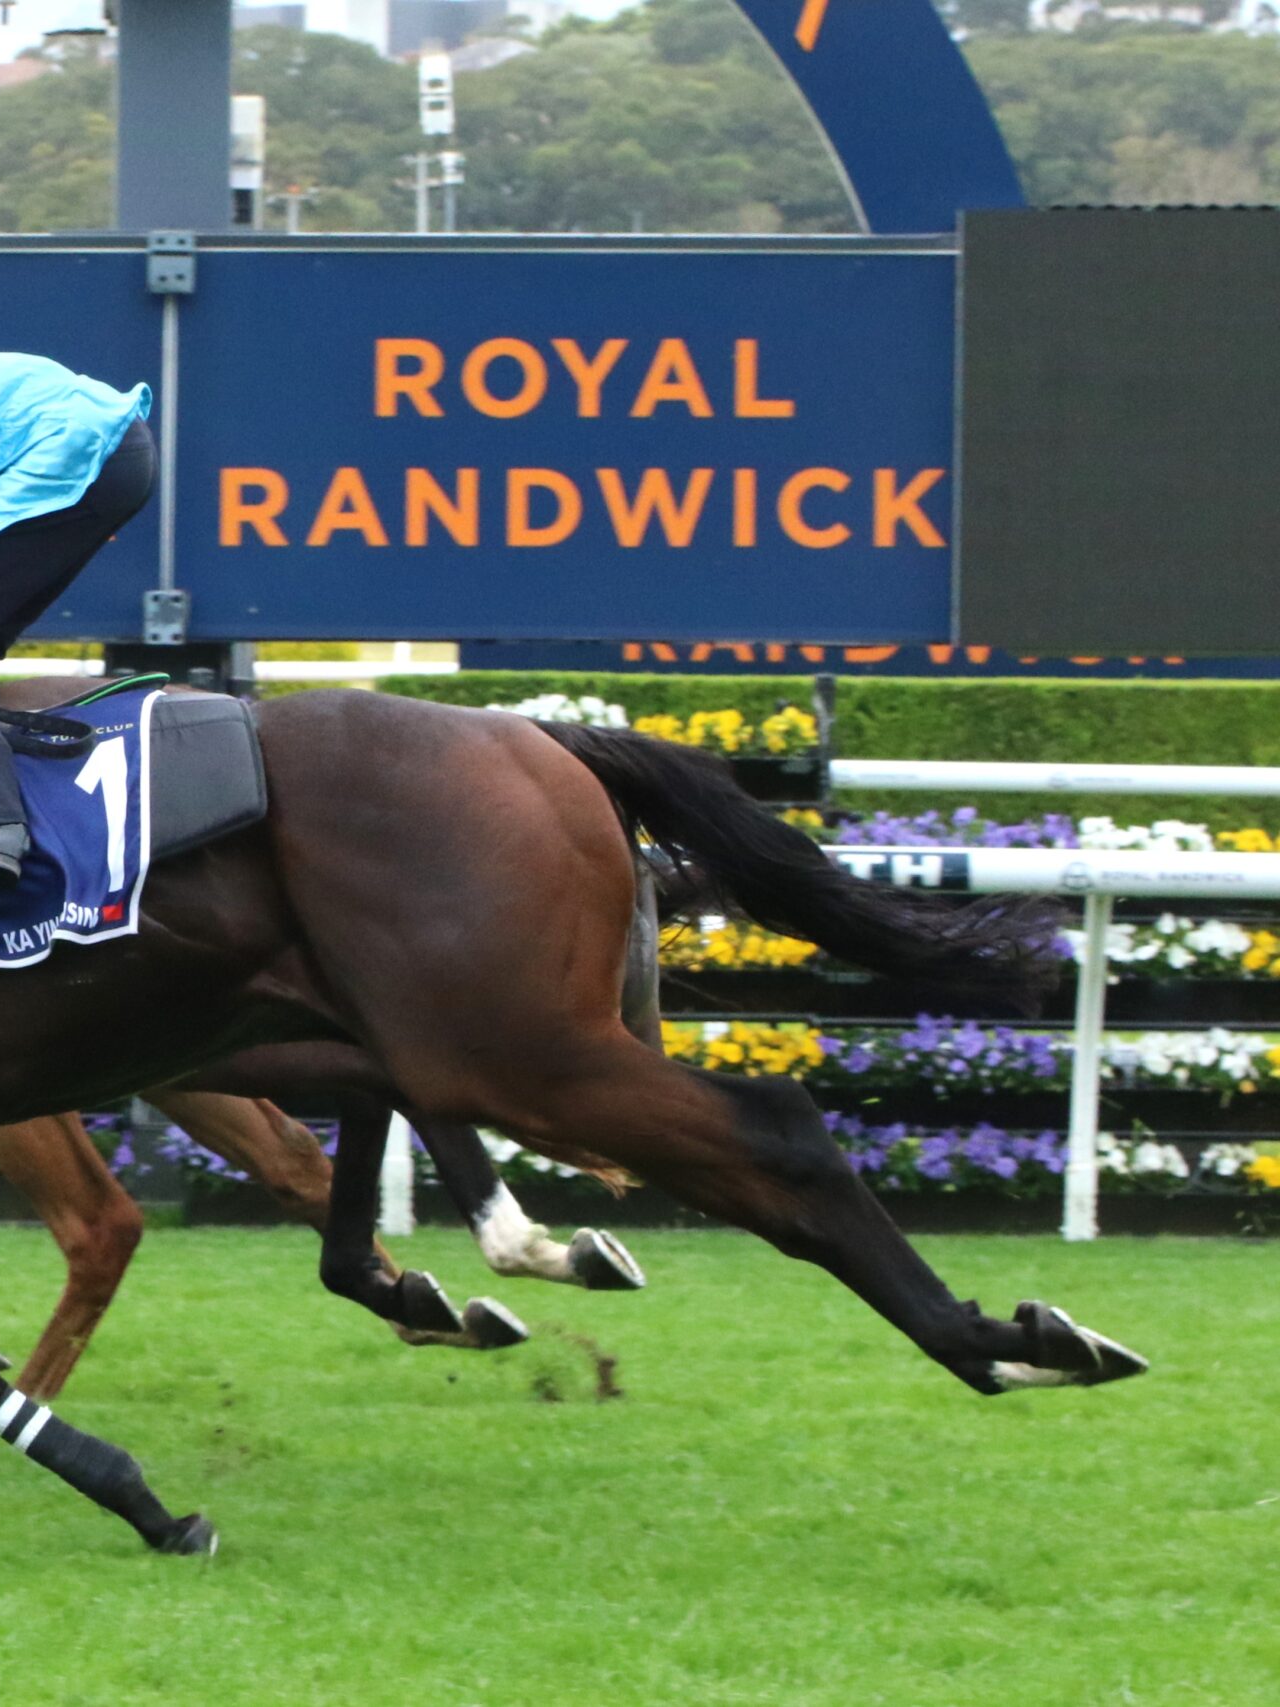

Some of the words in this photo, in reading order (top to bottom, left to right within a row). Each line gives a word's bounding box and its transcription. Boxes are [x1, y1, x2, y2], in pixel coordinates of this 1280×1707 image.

[377, 338, 793, 417] ROYAL
[221, 468, 942, 547] RANDWICK
[95, 722, 135, 735] CLUB
[74, 735, 128, 893] 1
[2, 928, 36, 954] KA
